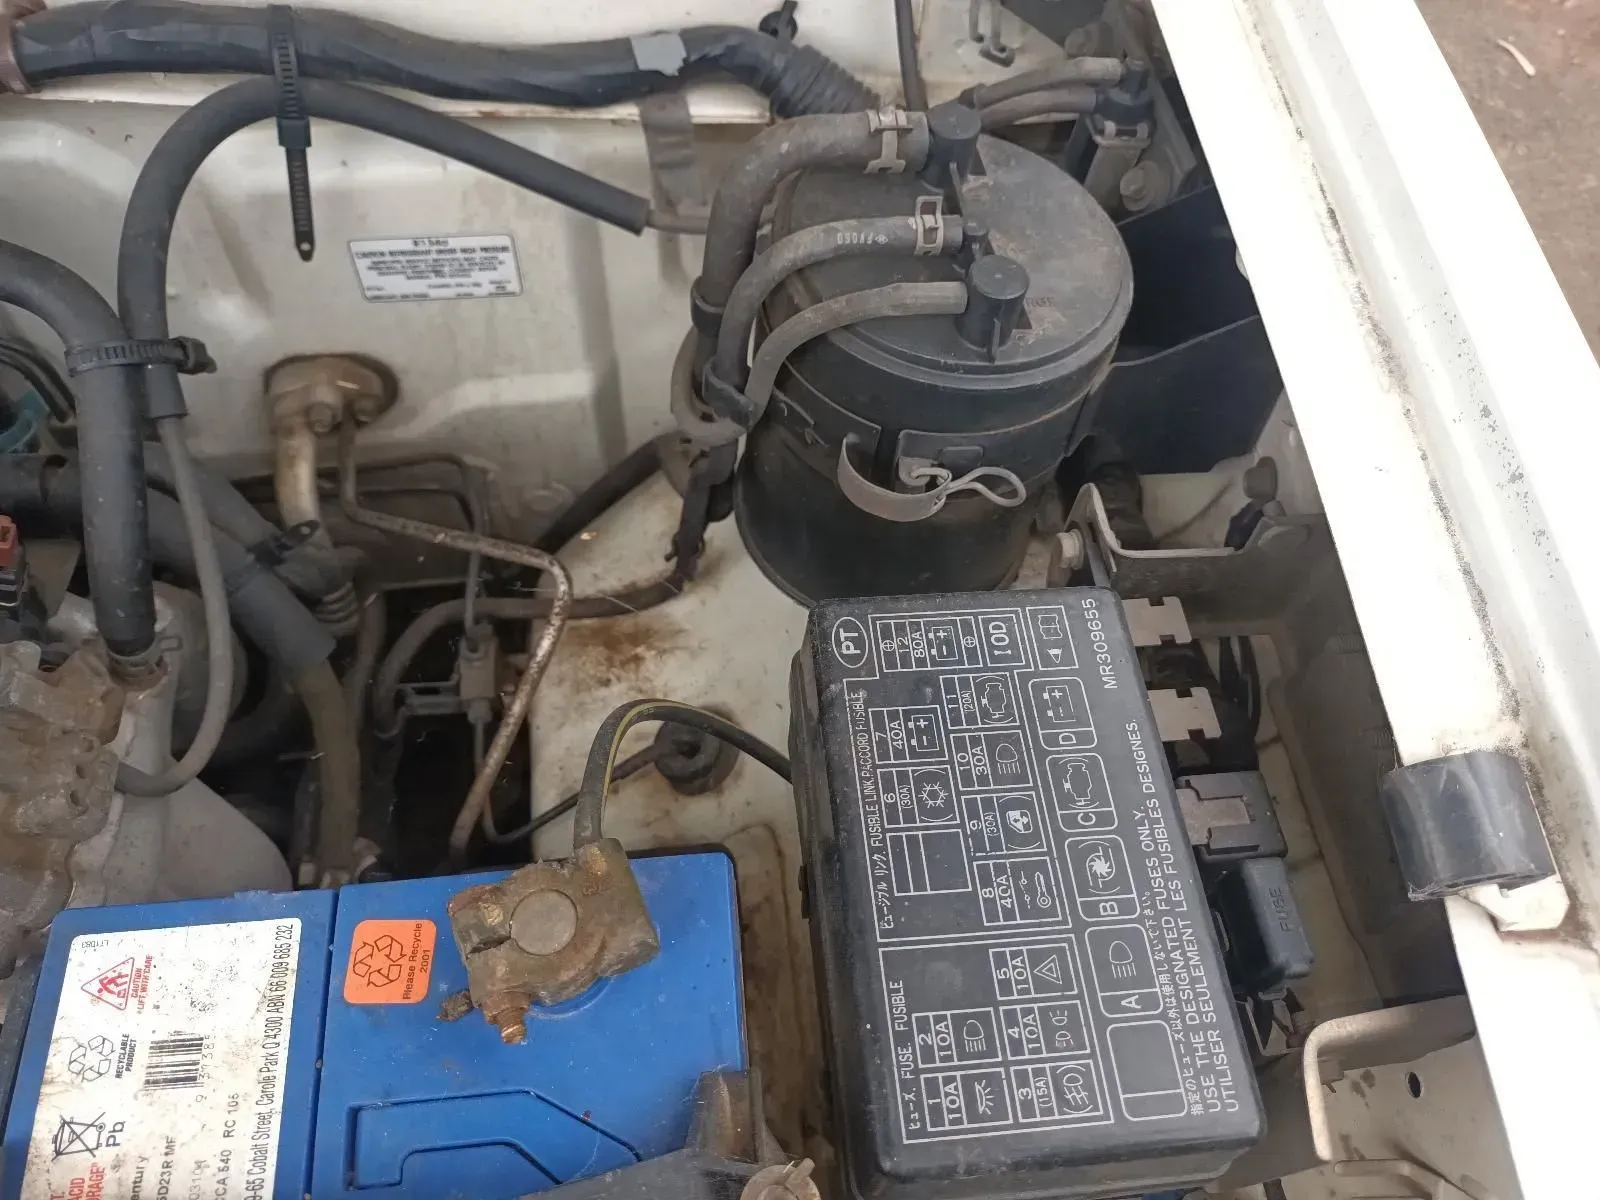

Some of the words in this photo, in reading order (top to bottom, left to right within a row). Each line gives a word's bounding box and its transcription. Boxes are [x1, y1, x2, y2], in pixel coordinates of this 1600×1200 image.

[840, 628, 861, 654] PT
[897, 637, 909, 653] 12
[912, 631, 925, 657] 80A
[989, 622, 1012, 655] IOD
[1082, 599, 1117, 688] MR309655
[850, 692, 867, 729] FUSIBLE
[946, 695, 958, 708] 11
[961, 691, 975, 712] (20A)
[876, 732, 886, 741] 7
[890, 721, 903, 749] 40A
[1059, 733, 1076, 744] D
[957, 753, 970, 770] 10
[972, 745, 987, 775] 30A
[1126, 719, 1155, 792] DESIGNES.
[884, 793, 895, 802] 6
[900, 785, 912, 808] (30A)
[866, 805, 883, 846] FUSIBLE
[970, 820, 981, 830] 9
[984, 812, 999, 836] (30A)
[1078, 813, 1096, 825] C
[1132, 806, 1155, 851] ONLY.
[1149, 799, 1178, 873] FUSIBLES
[982, 888, 994, 898] 8
[997, 875, 1012, 908] 40A
[1146, 858, 1170, 910] FUSES
[1168, 879, 1187, 912] LES
[1100, 902, 1118, 915] B
[1268, 888, 1294, 933] FUSE
[275, 924, 293, 940] 232
[409, 923, 422, 961] Recycle
[143, 955, 152, 973] CARE
[273, 943, 291, 959] 685
[420, 949, 430, 973] 2001
[131, 968, 142, 998] CAUTION
[140, 975, 149, 992] WITH
[270, 962, 289, 978] 009
[403, 966, 416, 999] Please
[997, 968, 1009, 978] 5
[1014, 956, 1028, 989] 10A
[1162, 916, 1200, 1024] DESIGNATED
[1179, 918, 1217, 1022] SEULEMENT
[269, 980, 286, 991] 66
[137, 995, 146, 1009] LIFT
[266, 994, 285, 1013] ABN
[890, 980, 908, 1030] FUSIBLE
[1121, 995, 1141, 1008] A
[1143, 892, 1204, 1115] 指定のヒューズ以外は使用しないで下さい。
[264, 1016, 283, 1039] 4300
[920, 1032, 932, 1045] 2
[935, 1021, 951, 1056] 10A
[1008, 1026, 1020, 1038] 4
[1027, 1014, 1041, 1047] 10A
[115, 1034, 129, 1078] RECYCLABLE
[125, 1039, 137, 1072] PRODUCT
[259, 1052, 279, 1072] Park
[899, 1043, 915, 1078] FUSE.
[1190, 1031, 1210, 1068] THE
[1208, 1030, 1238, 1112] UTILISER
[256, 1076, 276, 1105] Carole
[947, 1082, 962, 1119] 10A
[1018, 1087, 1031, 1099] 3
[1035, 1077, 1052, 1107] (15A)
[1201, 1074, 1220, 1112] USE
[105, 1121, 124, 1147] Pb
[223, 1120, 236, 1138] RC
[247, 1143, 269, 1175] Cobalt
